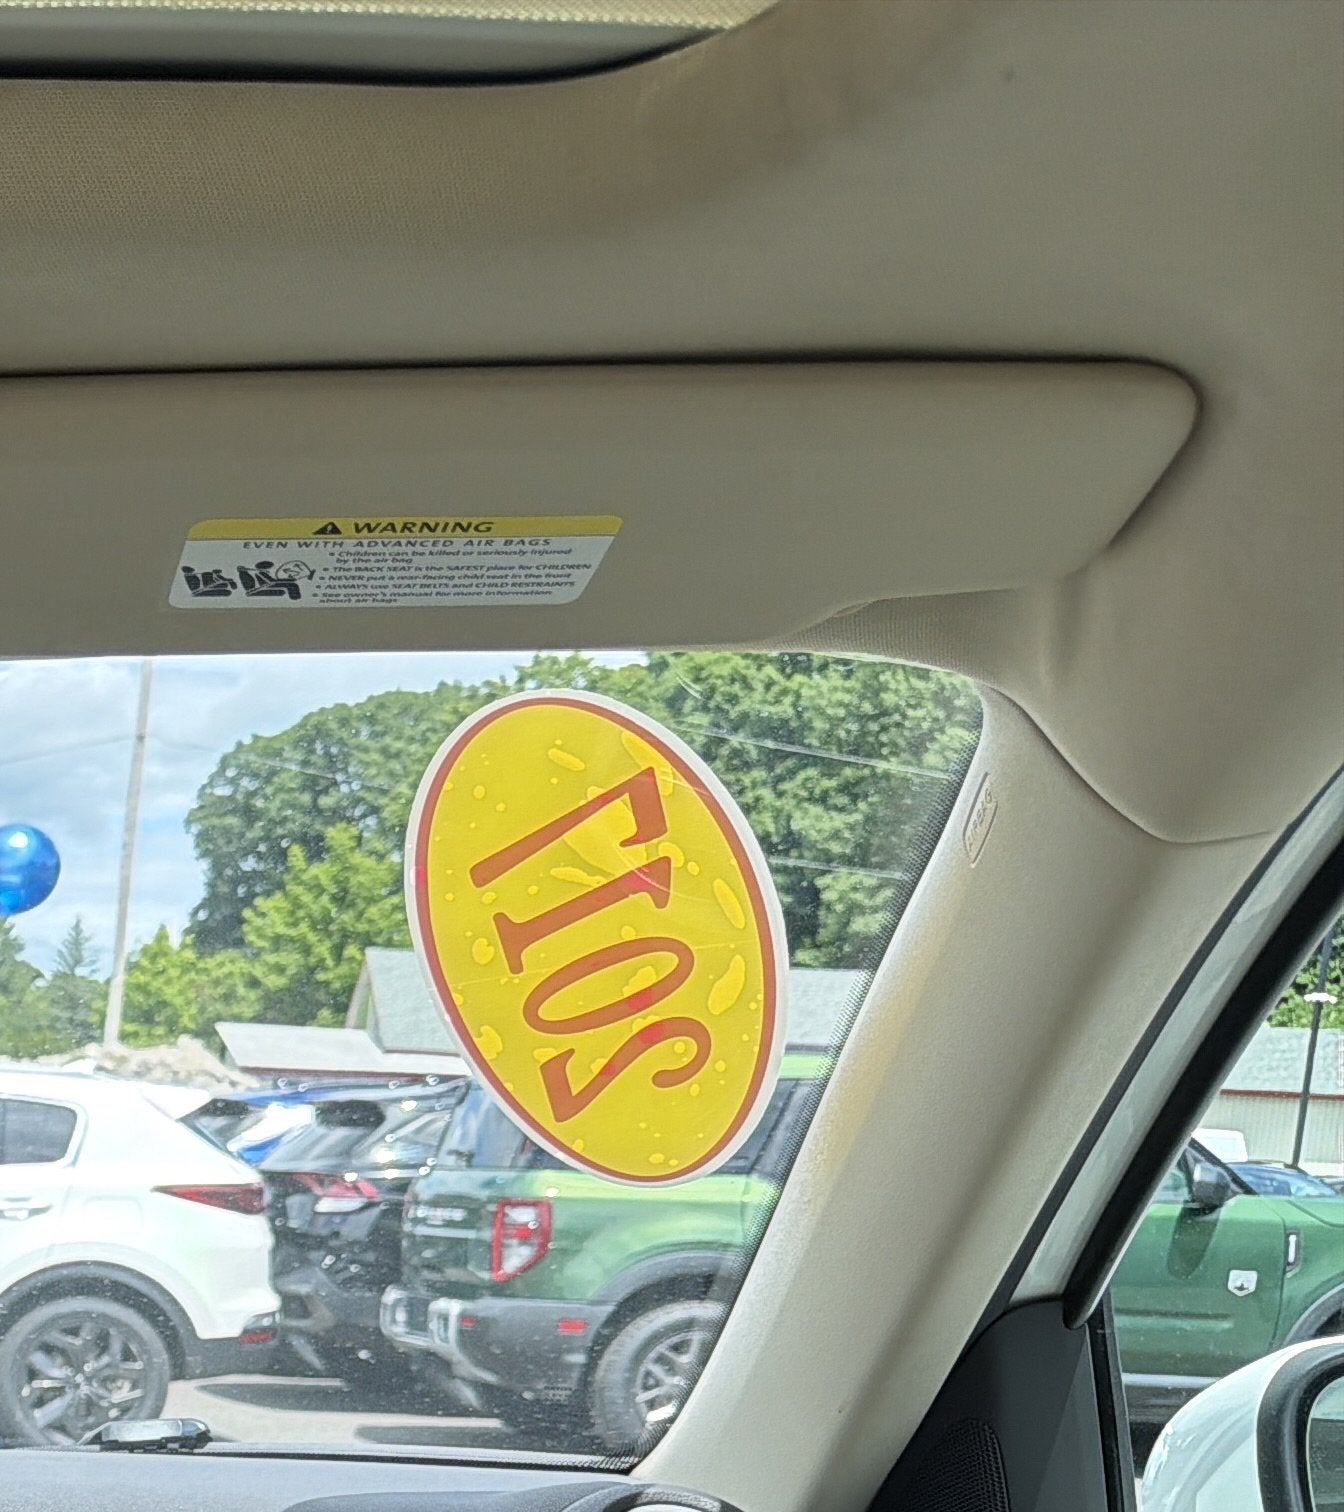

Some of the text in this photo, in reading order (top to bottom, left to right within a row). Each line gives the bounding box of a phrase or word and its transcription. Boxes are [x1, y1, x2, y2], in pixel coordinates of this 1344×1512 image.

[353, 522, 494, 533] WARNING
[242, 538, 552, 549] EVEN WITH ADVANCED AIR BAGS
